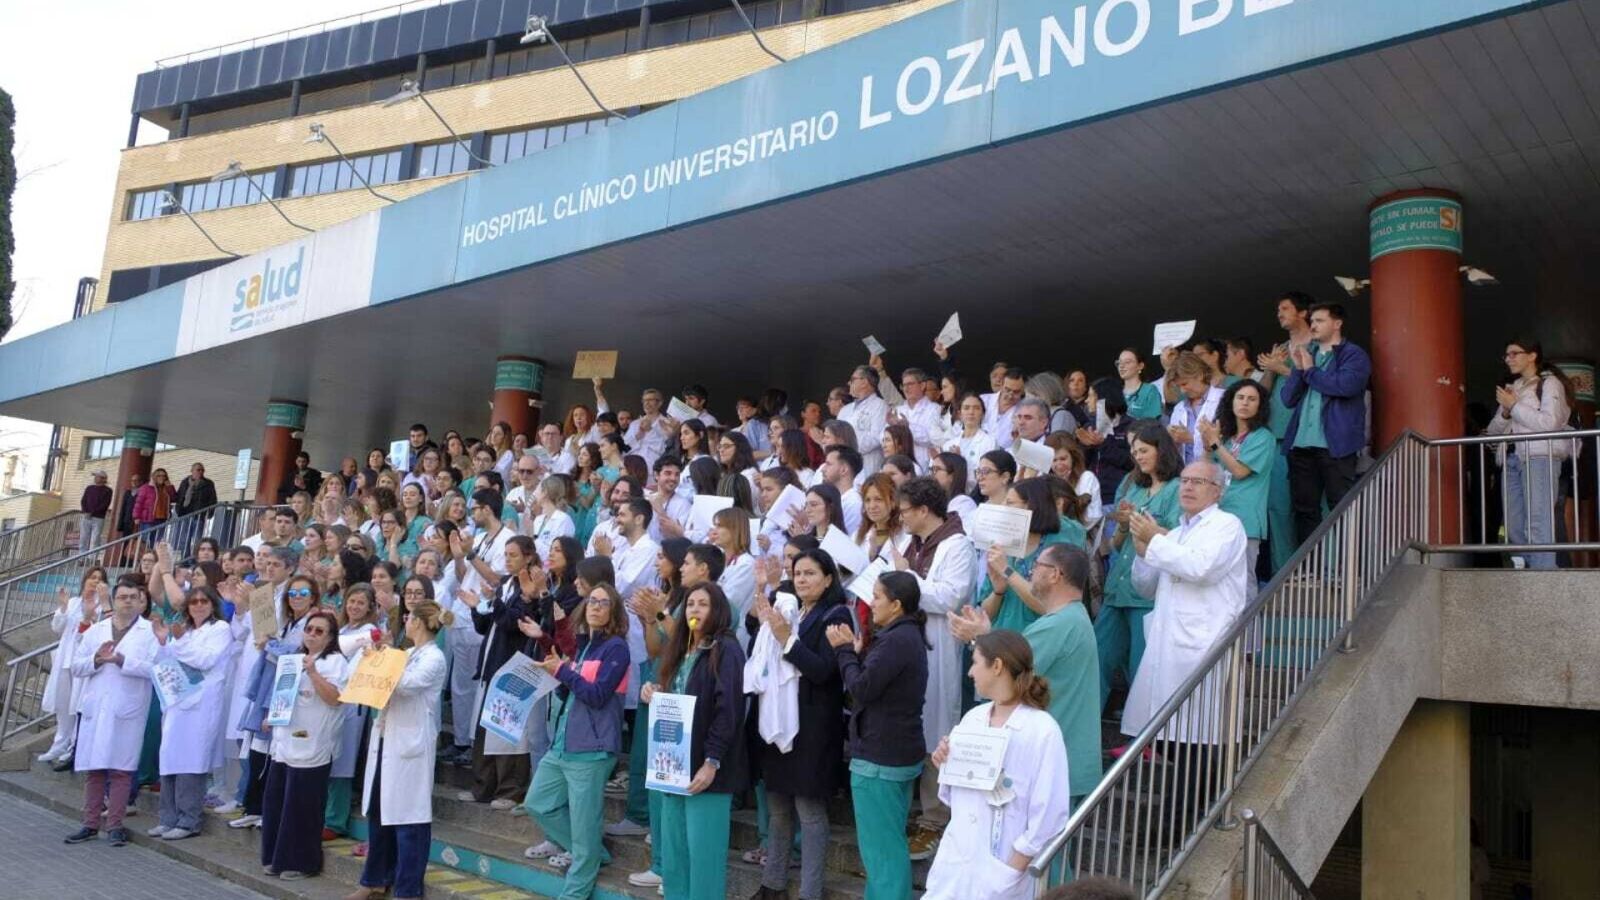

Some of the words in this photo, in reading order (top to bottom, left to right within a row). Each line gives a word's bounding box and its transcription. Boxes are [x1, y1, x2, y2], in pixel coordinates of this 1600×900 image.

[462, 204, 548, 248] HOSPITAL
[553, 173, 637, 221] CLÍNICO
[643, 109, 840, 193] UNIVERSITARIO
[858, 0, 1151, 130] LOZANO
[1178, 0, 1293, 36] B
[232, 246, 305, 312] salud
